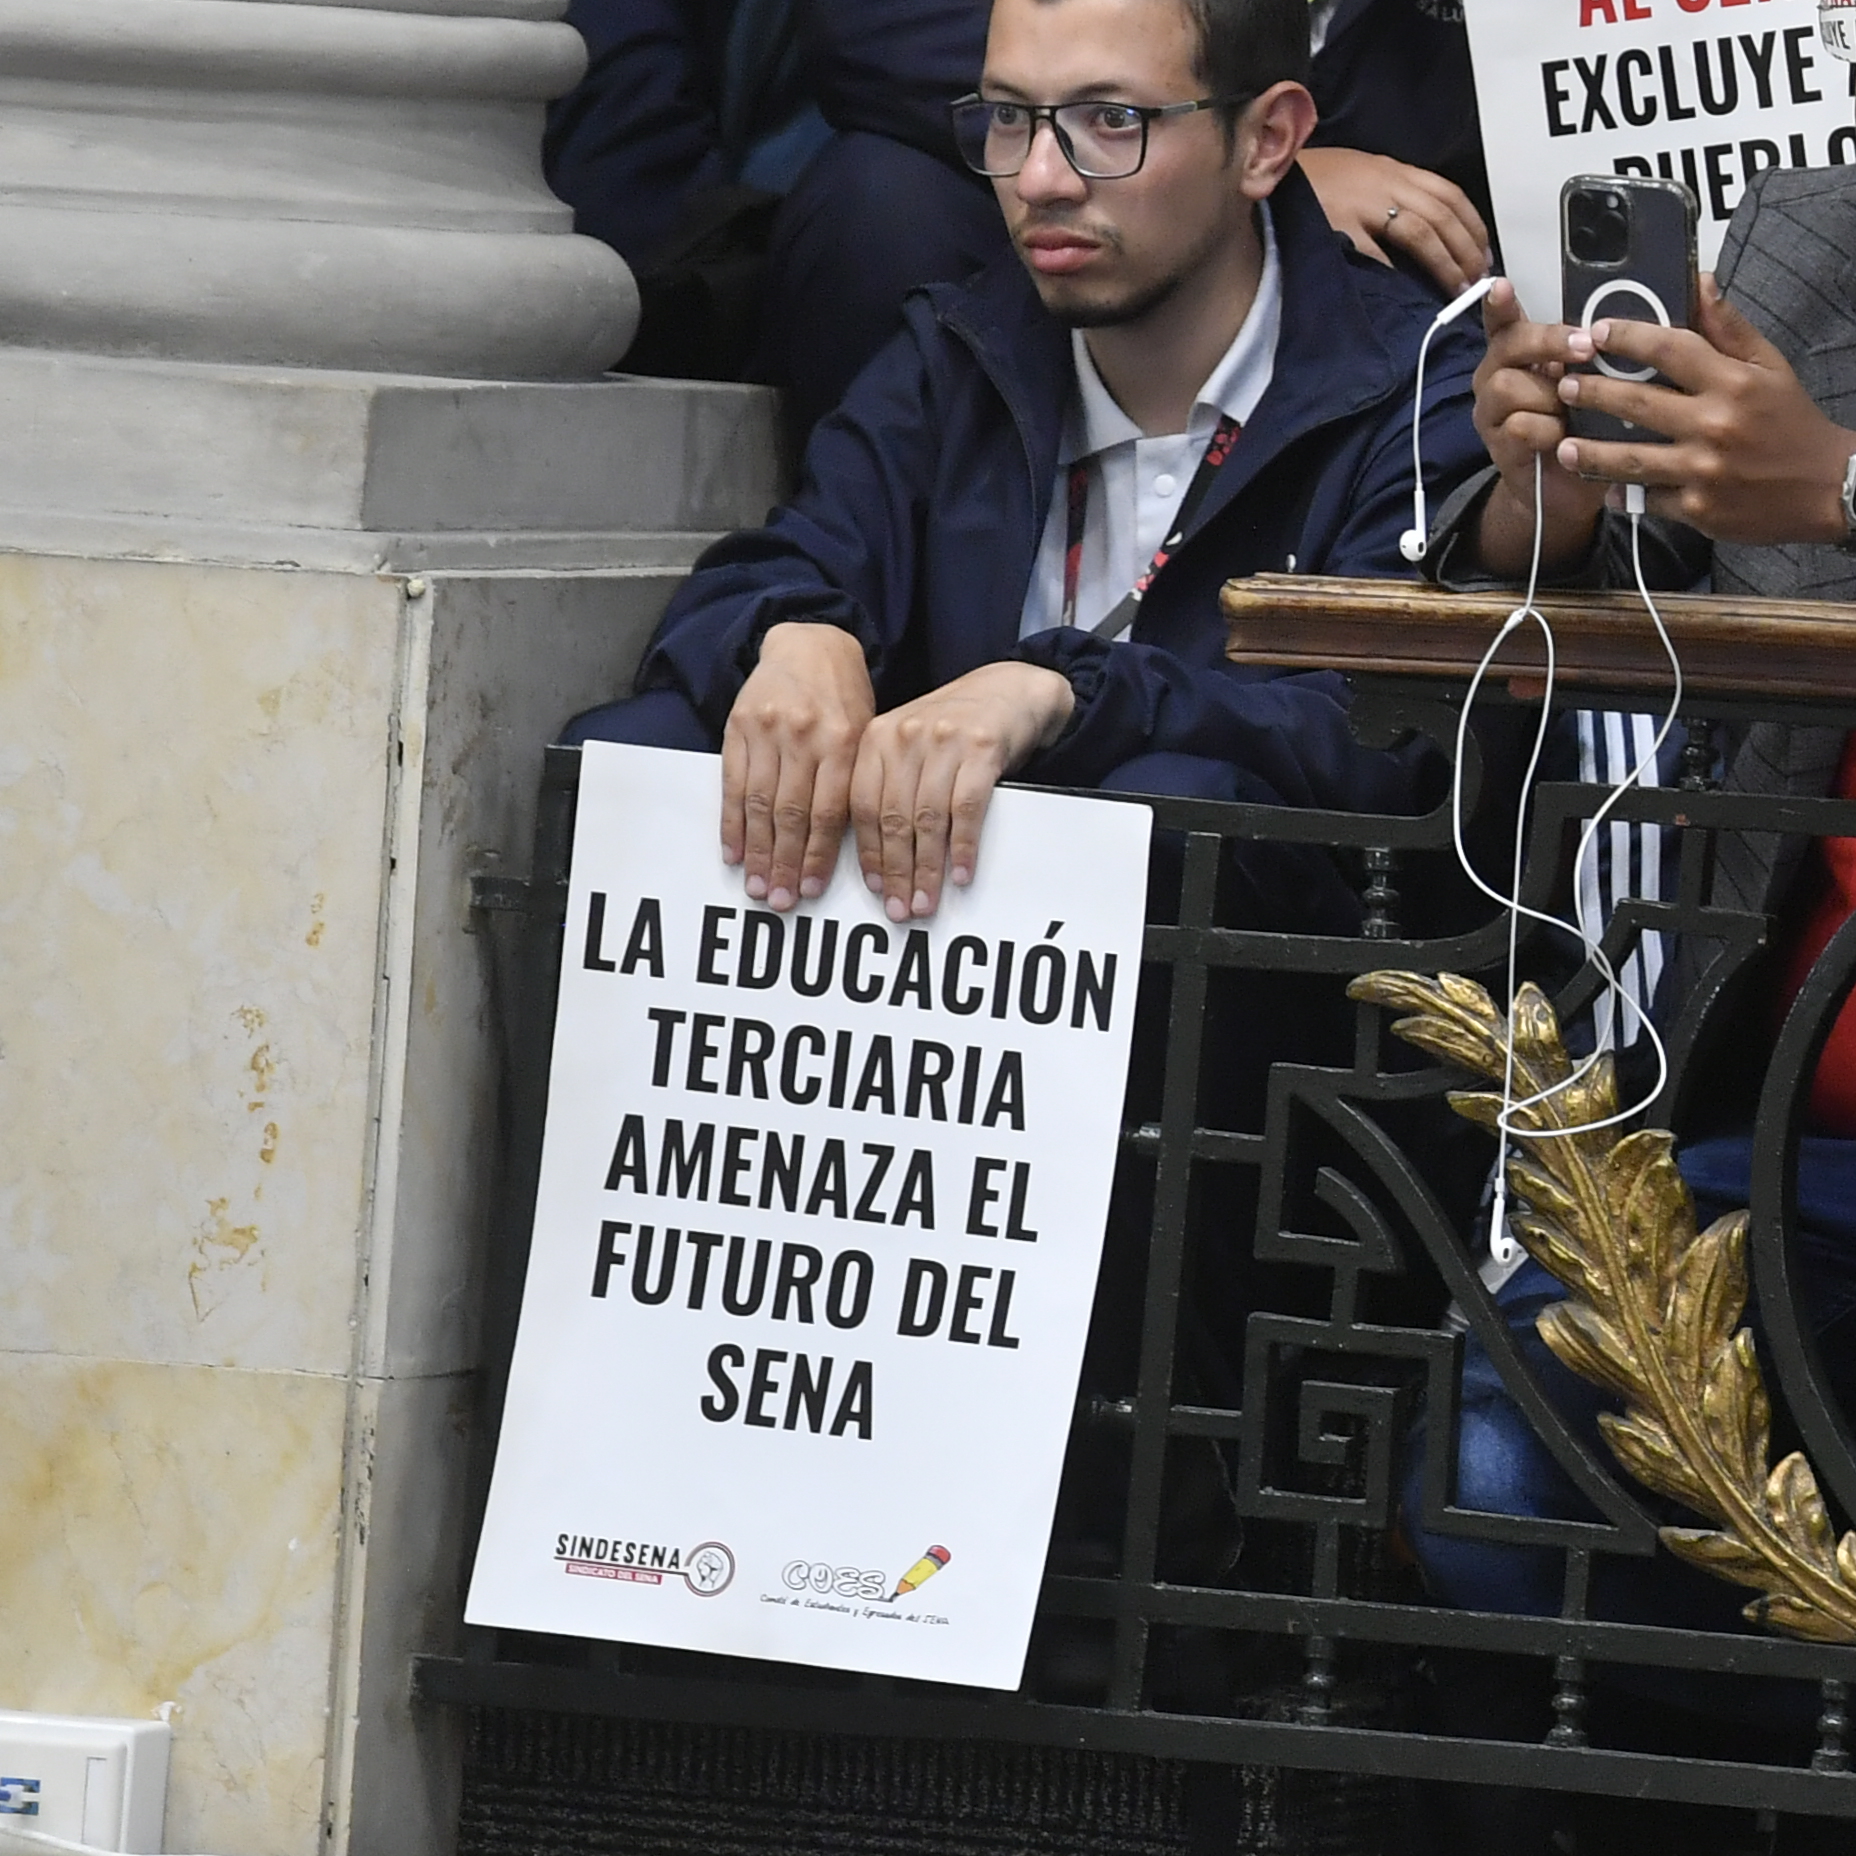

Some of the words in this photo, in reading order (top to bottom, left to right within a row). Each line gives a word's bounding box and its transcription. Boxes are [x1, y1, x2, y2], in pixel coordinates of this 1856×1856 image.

[1541, 26, 1822, 137] EXCLUYE
[583, 892, 664, 978] LA
[696, 904, 1117, 1032] EDUCACIÓN
[648, 1008, 1025, 1131] TERCIARIA
[604, 1114, 935, 1230] AMENAZA
[966, 1157, 1038, 1242] EL
[591, 1220, 874, 1329] FUTURO
[897, 1258, 1019, 1349] DEL
[701, 1344, 872, 1440] SENA
[555, 1533, 680, 1570] SINDESENA
[782, 1560, 885, 1600] COES
